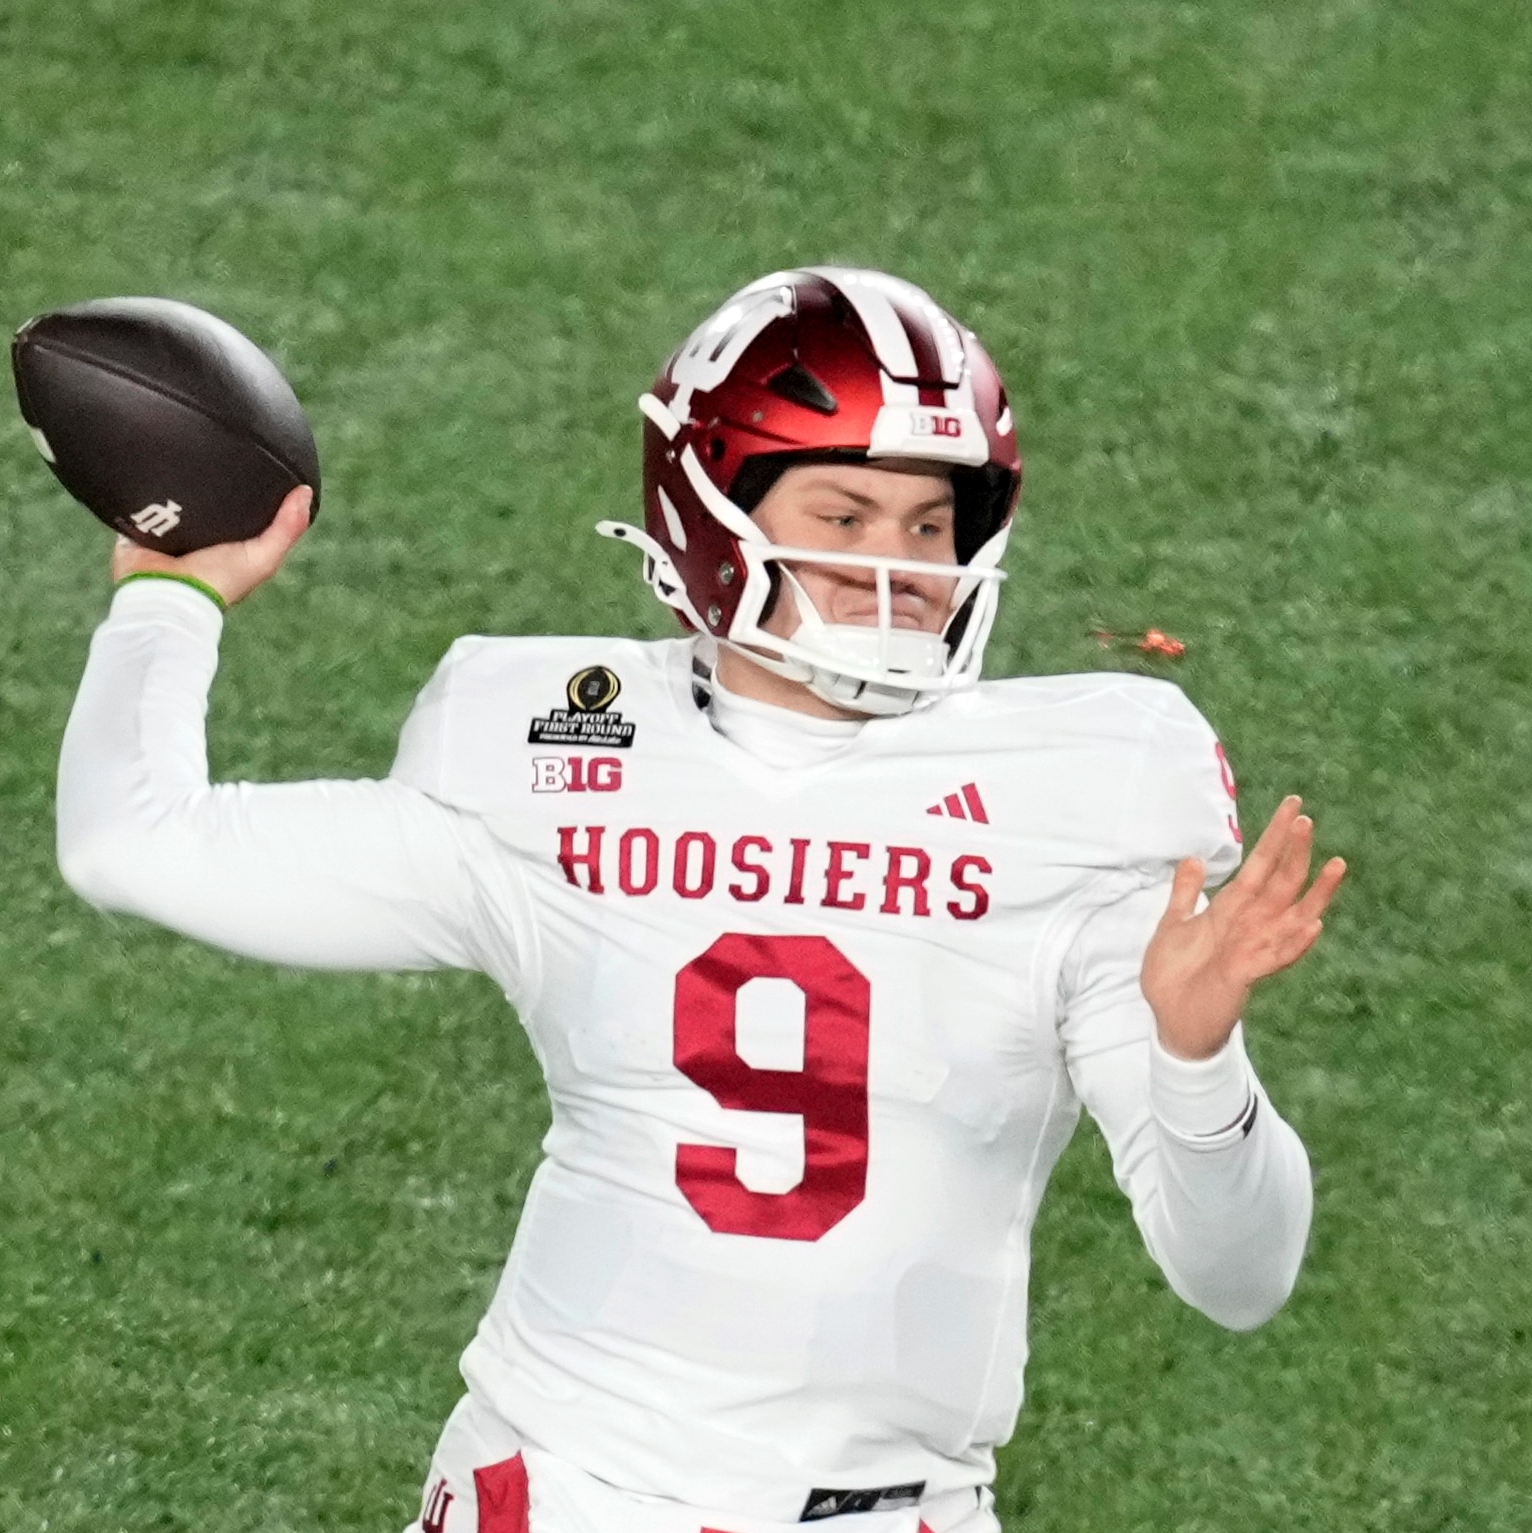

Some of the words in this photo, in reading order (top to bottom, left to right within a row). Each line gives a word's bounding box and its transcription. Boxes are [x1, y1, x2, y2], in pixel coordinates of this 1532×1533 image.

[533, 719, 580, 734] FIRST
[580, 722, 633, 737] ROUND
[557, 825, 993, 921] HOOSIERS
[673, 932, 871, 1242] 9
